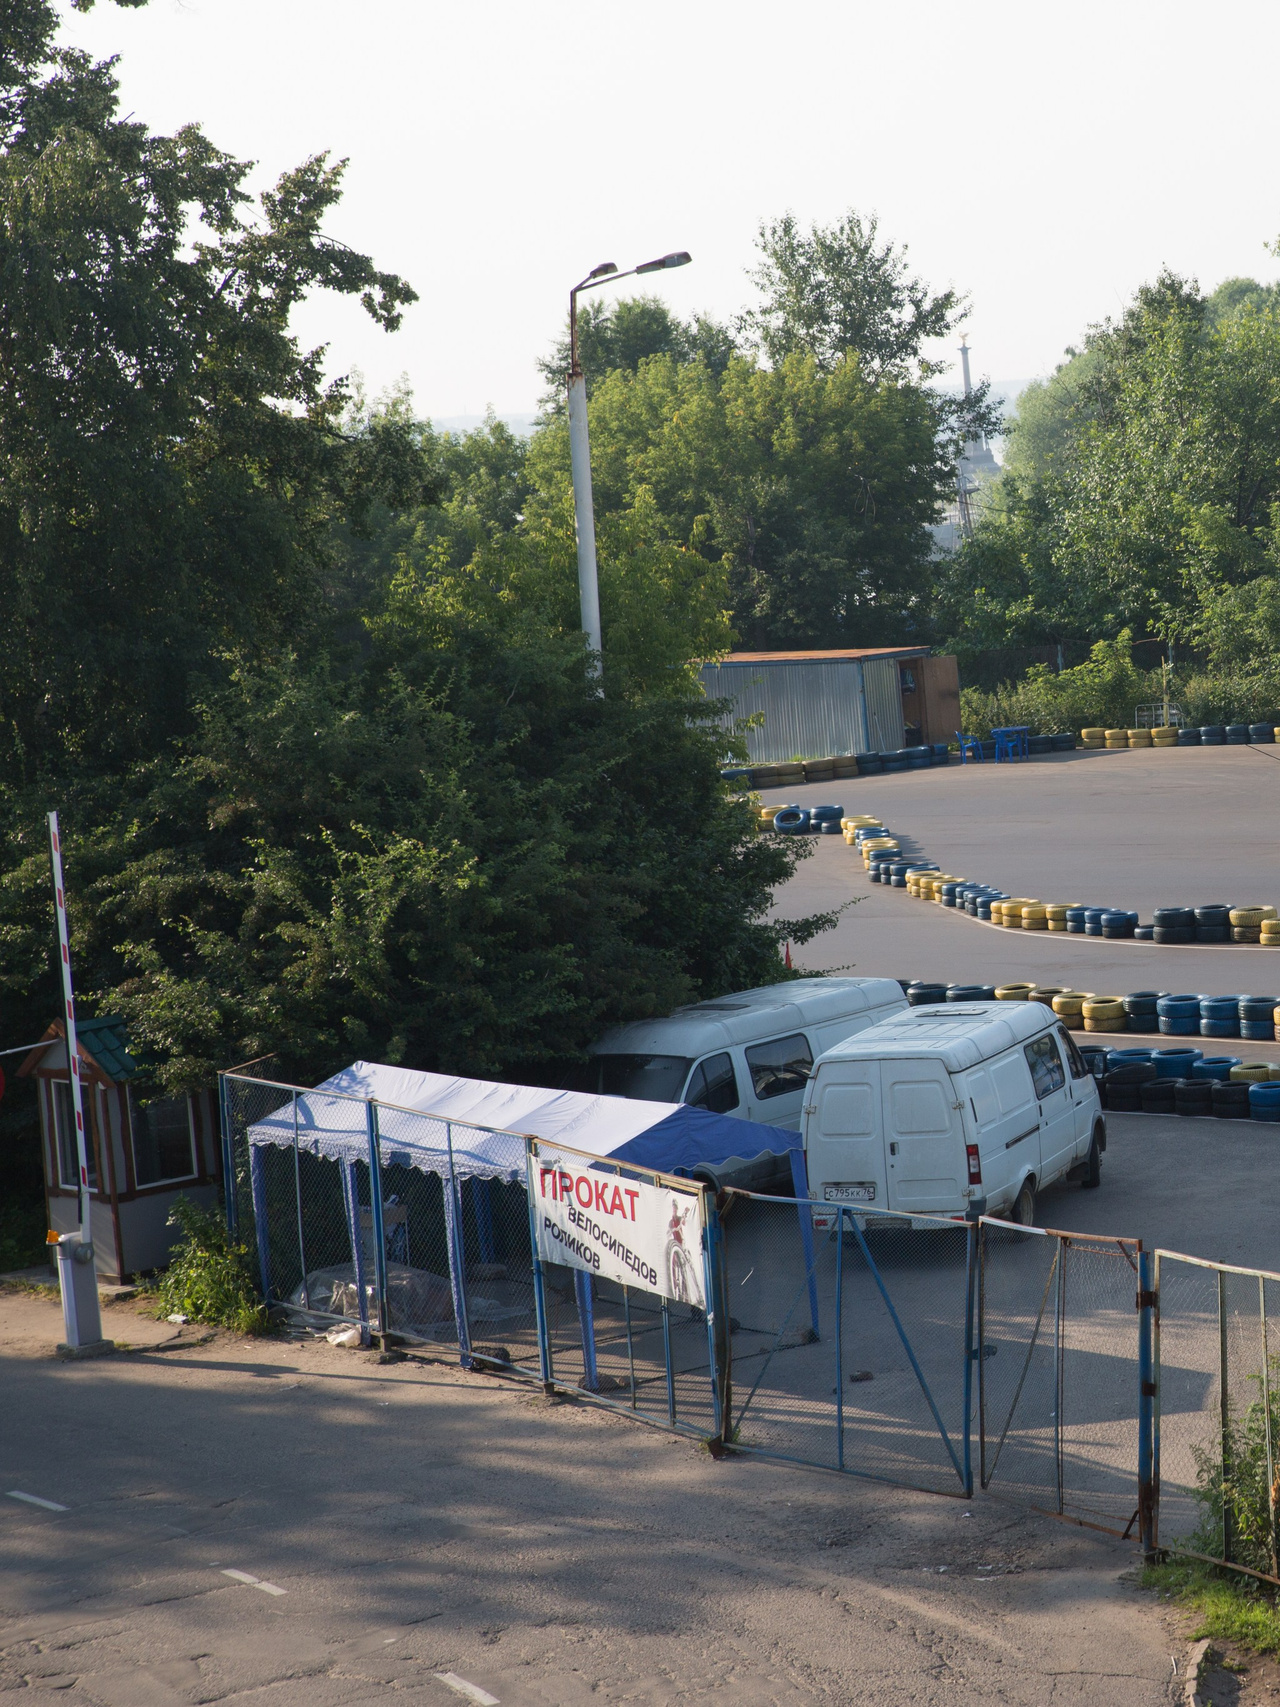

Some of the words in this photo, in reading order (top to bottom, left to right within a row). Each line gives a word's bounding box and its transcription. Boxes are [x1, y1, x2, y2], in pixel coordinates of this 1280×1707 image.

[540, 1168, 640, 1222] ПРОКАТ
[544, 1216, 601, 1270] РОЛИКОВ
[568, 1205, 657, 1286] ВЕЛОСИПЕДОВ
